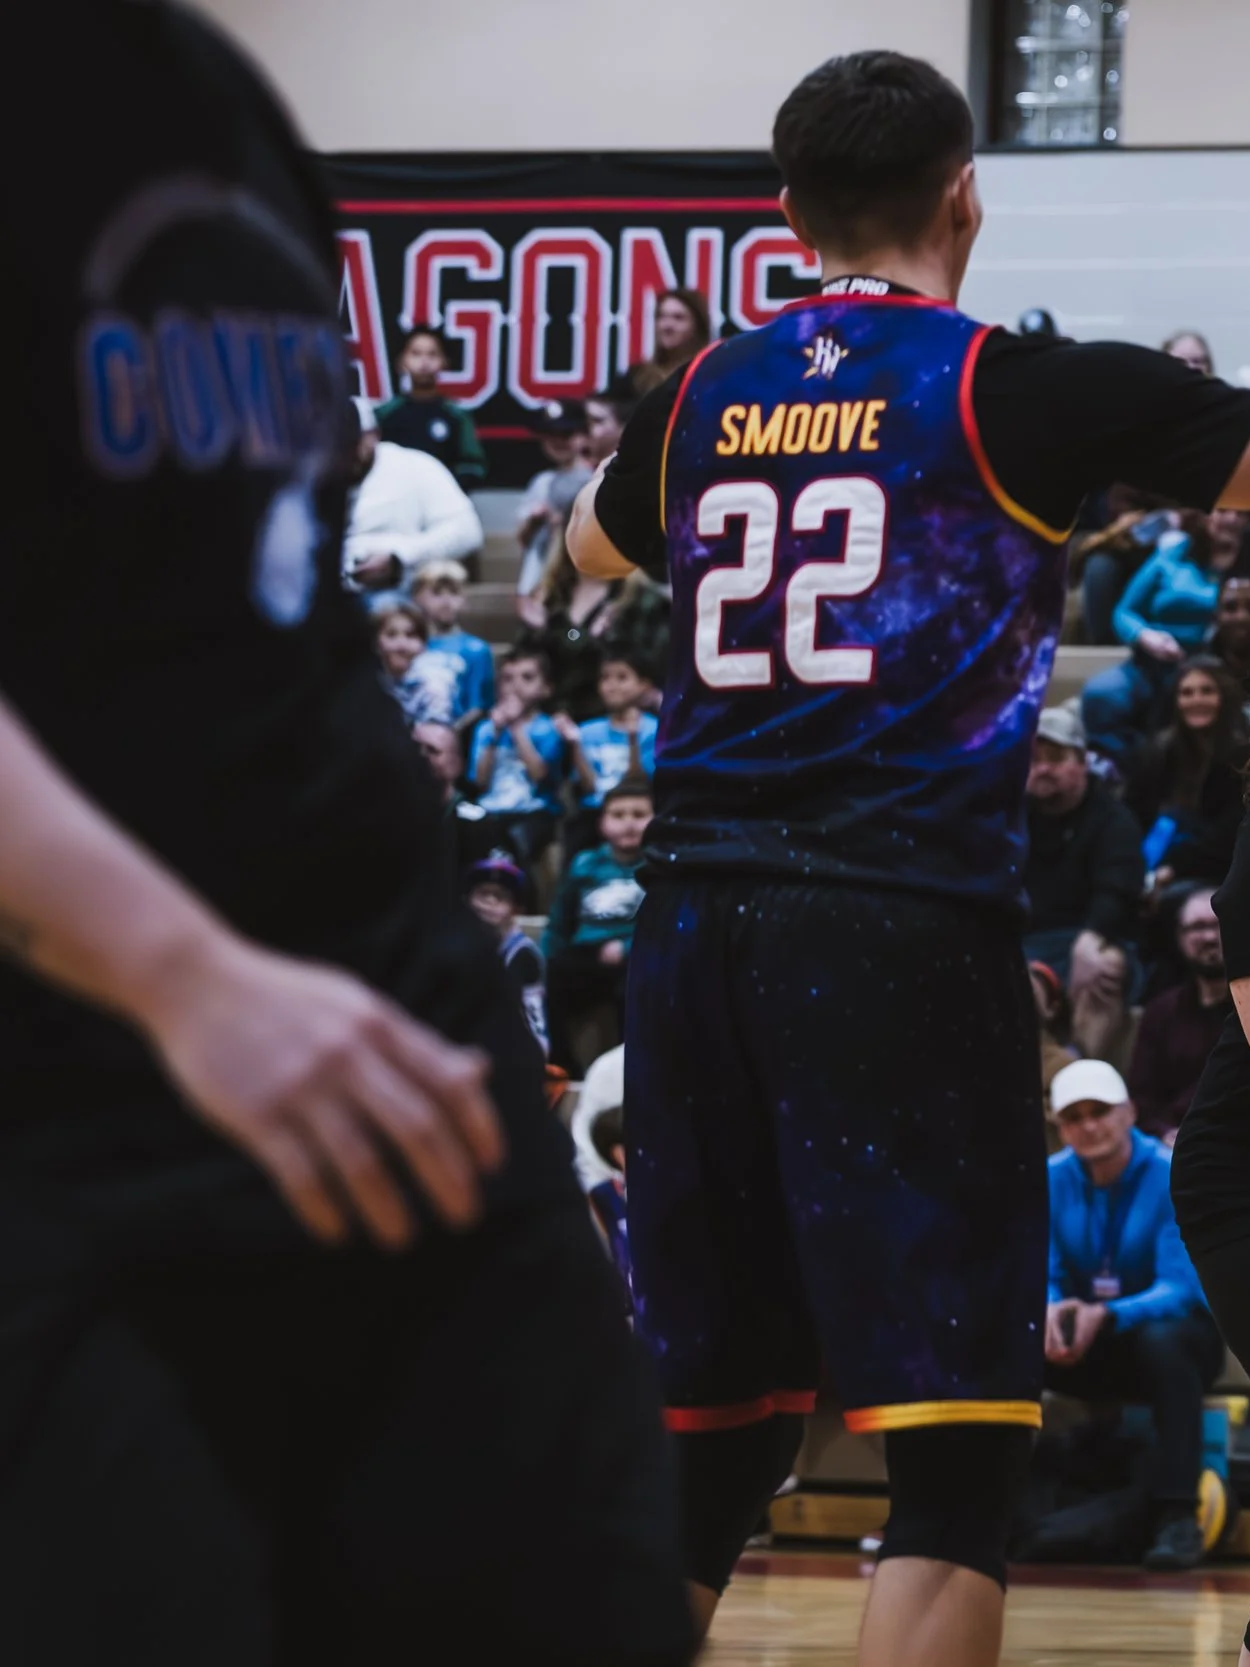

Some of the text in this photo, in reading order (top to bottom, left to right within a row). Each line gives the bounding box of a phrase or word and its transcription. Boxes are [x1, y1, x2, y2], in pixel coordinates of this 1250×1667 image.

[848, 277, 890, 296] PRO
[716, 400, 887, 456] SMOOVE
[693, 474, 890, 690] 22
